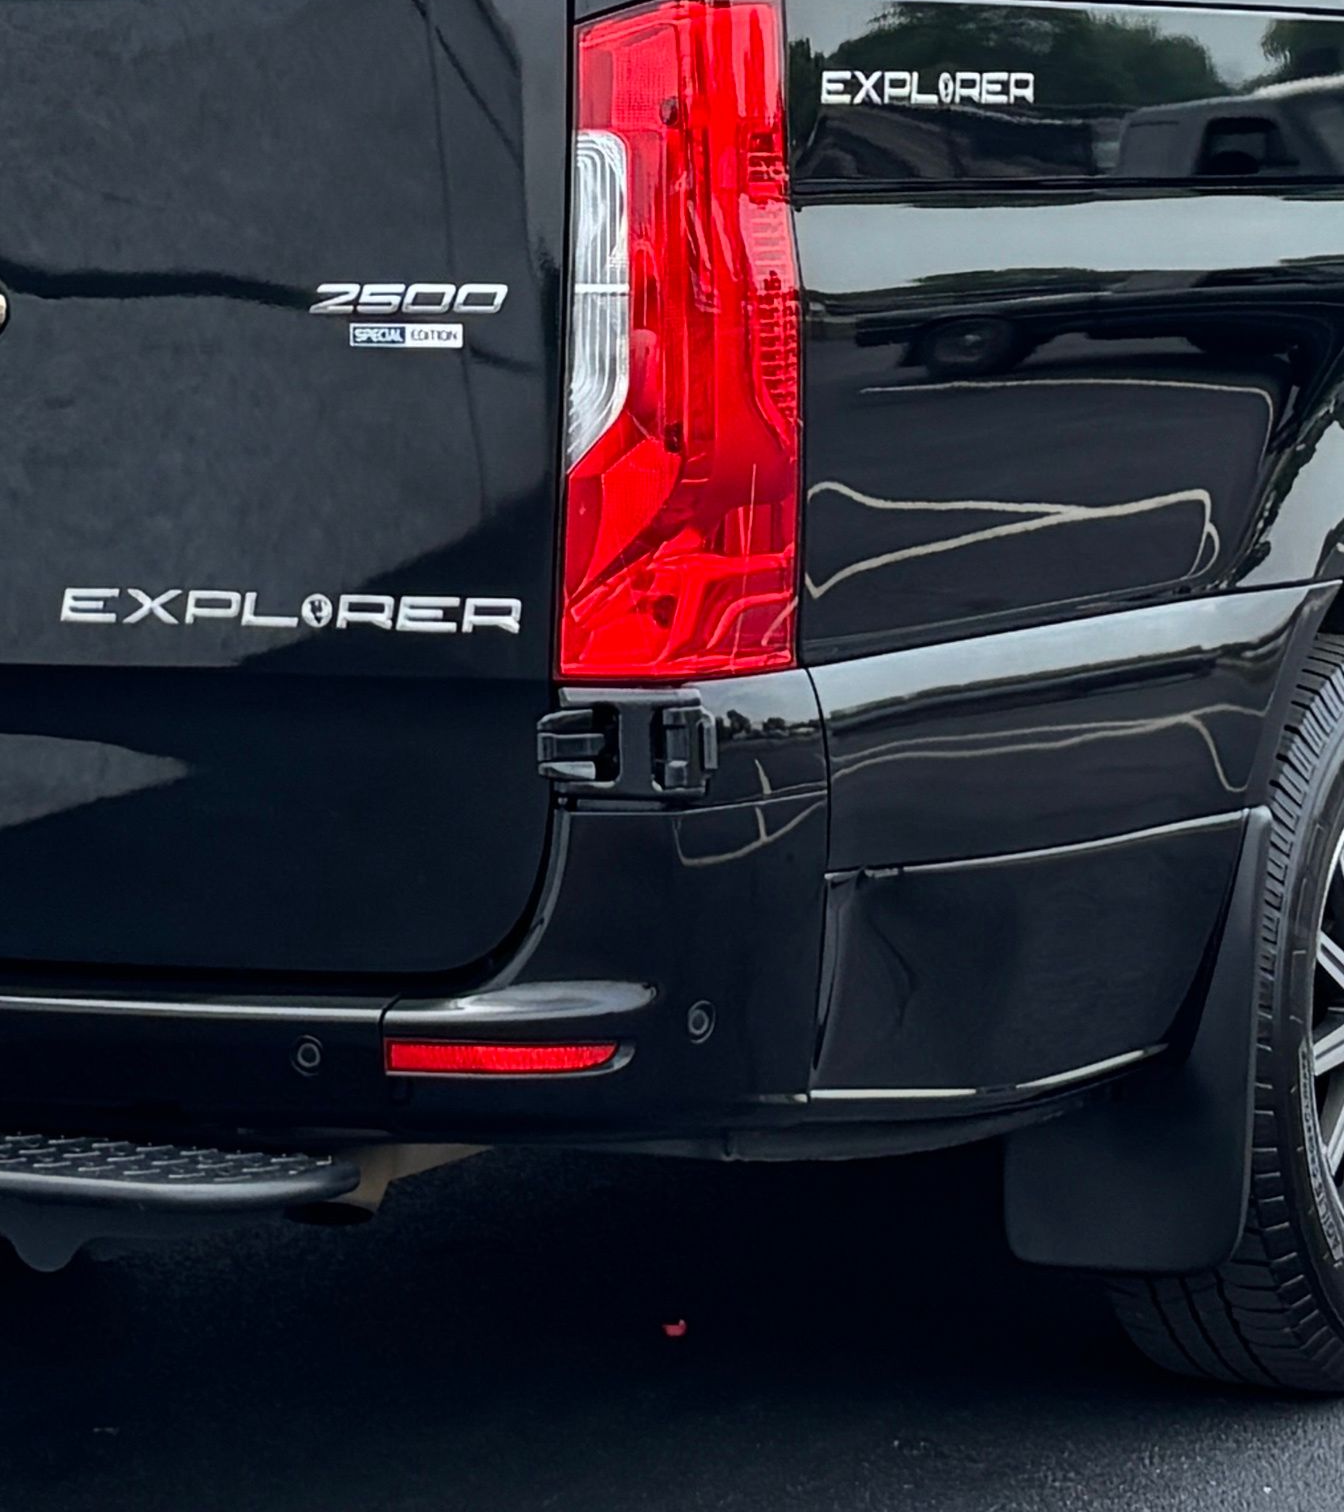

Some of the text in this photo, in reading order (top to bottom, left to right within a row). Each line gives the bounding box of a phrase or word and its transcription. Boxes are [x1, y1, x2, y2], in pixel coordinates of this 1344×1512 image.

[821, 71, 1034, 104] EXPLORER
[309, 283, 508, 314] 2500
[354, 328, 457, 342] SPECIAL EDITION
[60, 587, 522, 634] EXPLORER
